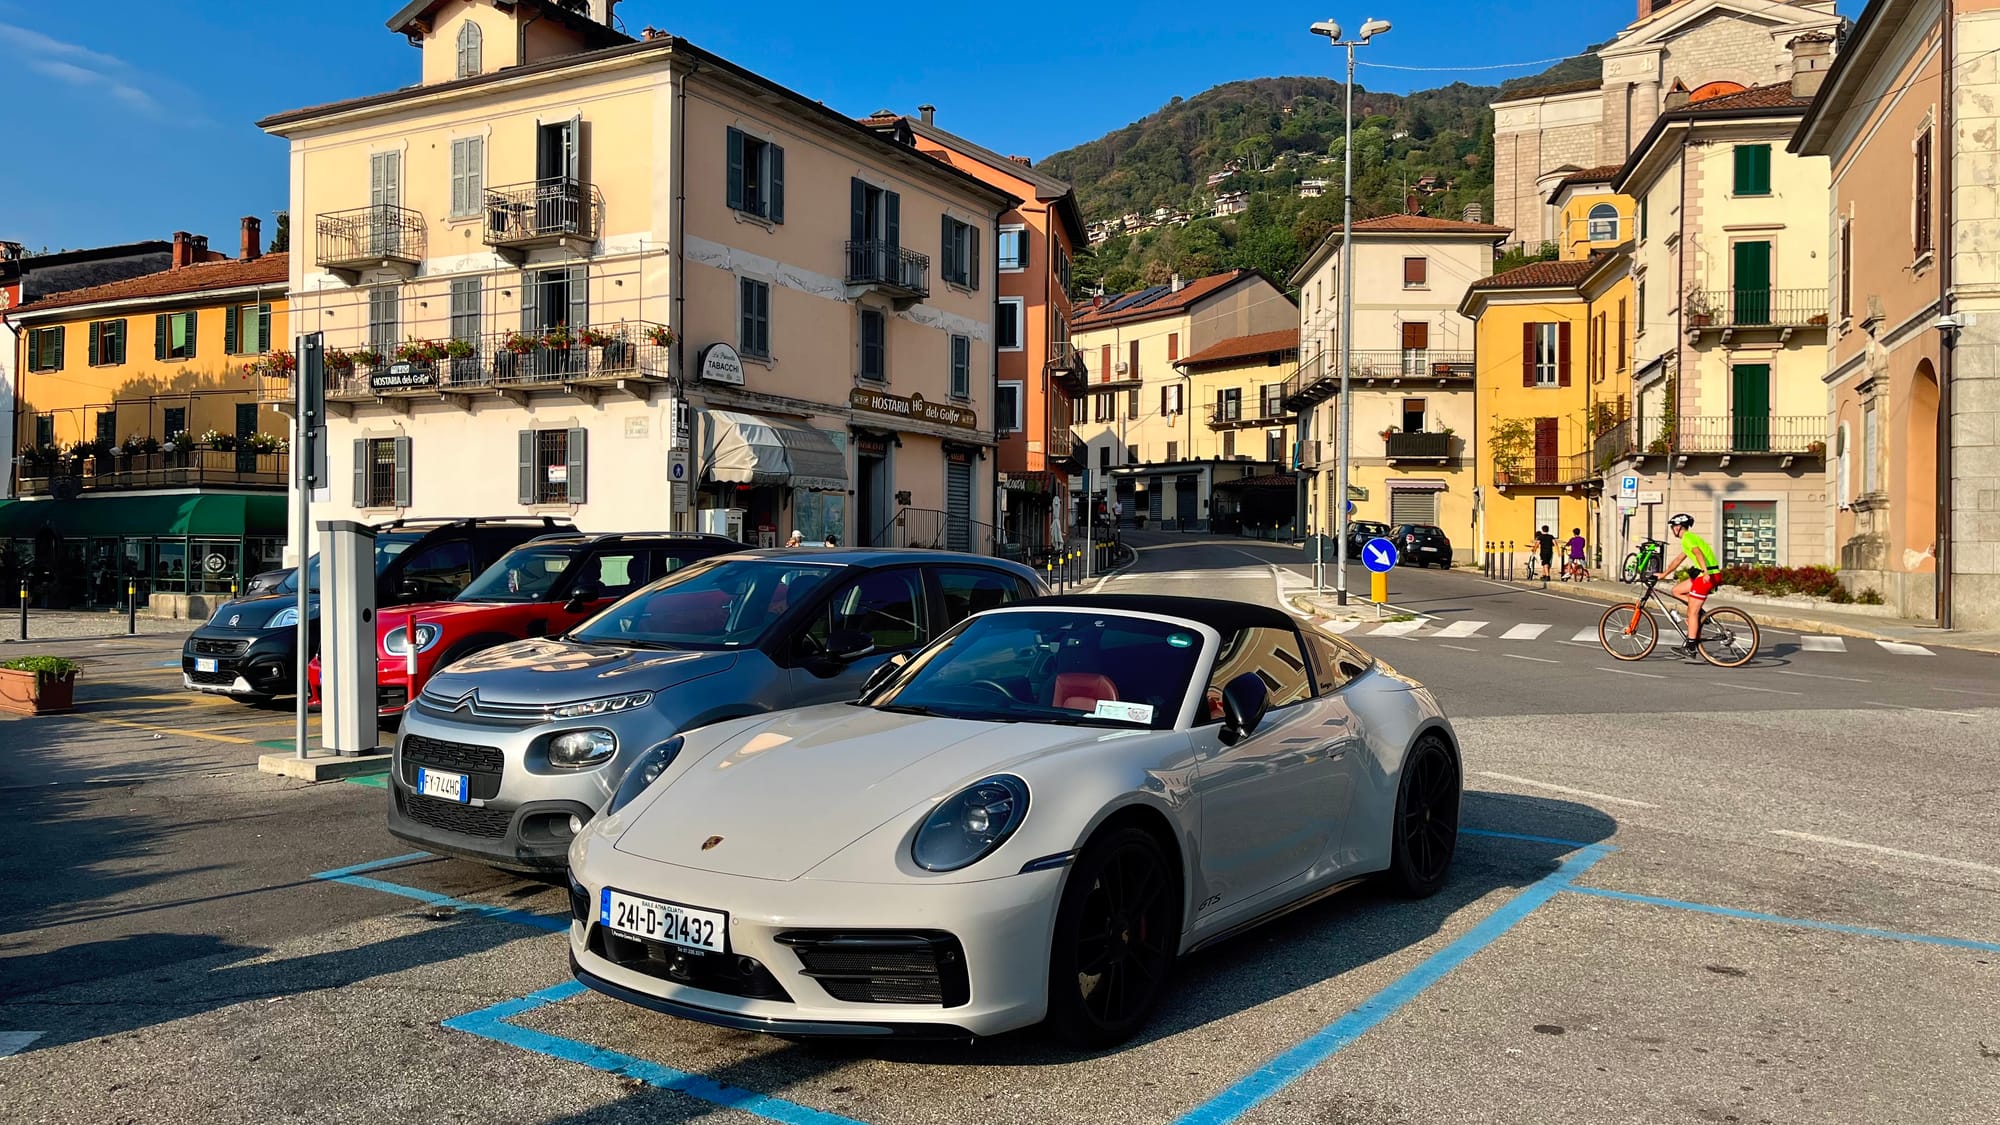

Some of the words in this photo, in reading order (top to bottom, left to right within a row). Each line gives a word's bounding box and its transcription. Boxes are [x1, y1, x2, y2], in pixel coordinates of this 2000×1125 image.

[708, 360, 739, 373] TABACCHI
[373, 376, 402, 386] HOSTARIA
[872, 396, 909, 414] HOSTARIA
[913, 400, 923, 412] HG
[940, 408, 959, 424] Golfo
[1625, 478, 1634, 488] P
[1199, 893, 1221, 911] GTS
[617, 902, 714, 947] 241-D-21432
